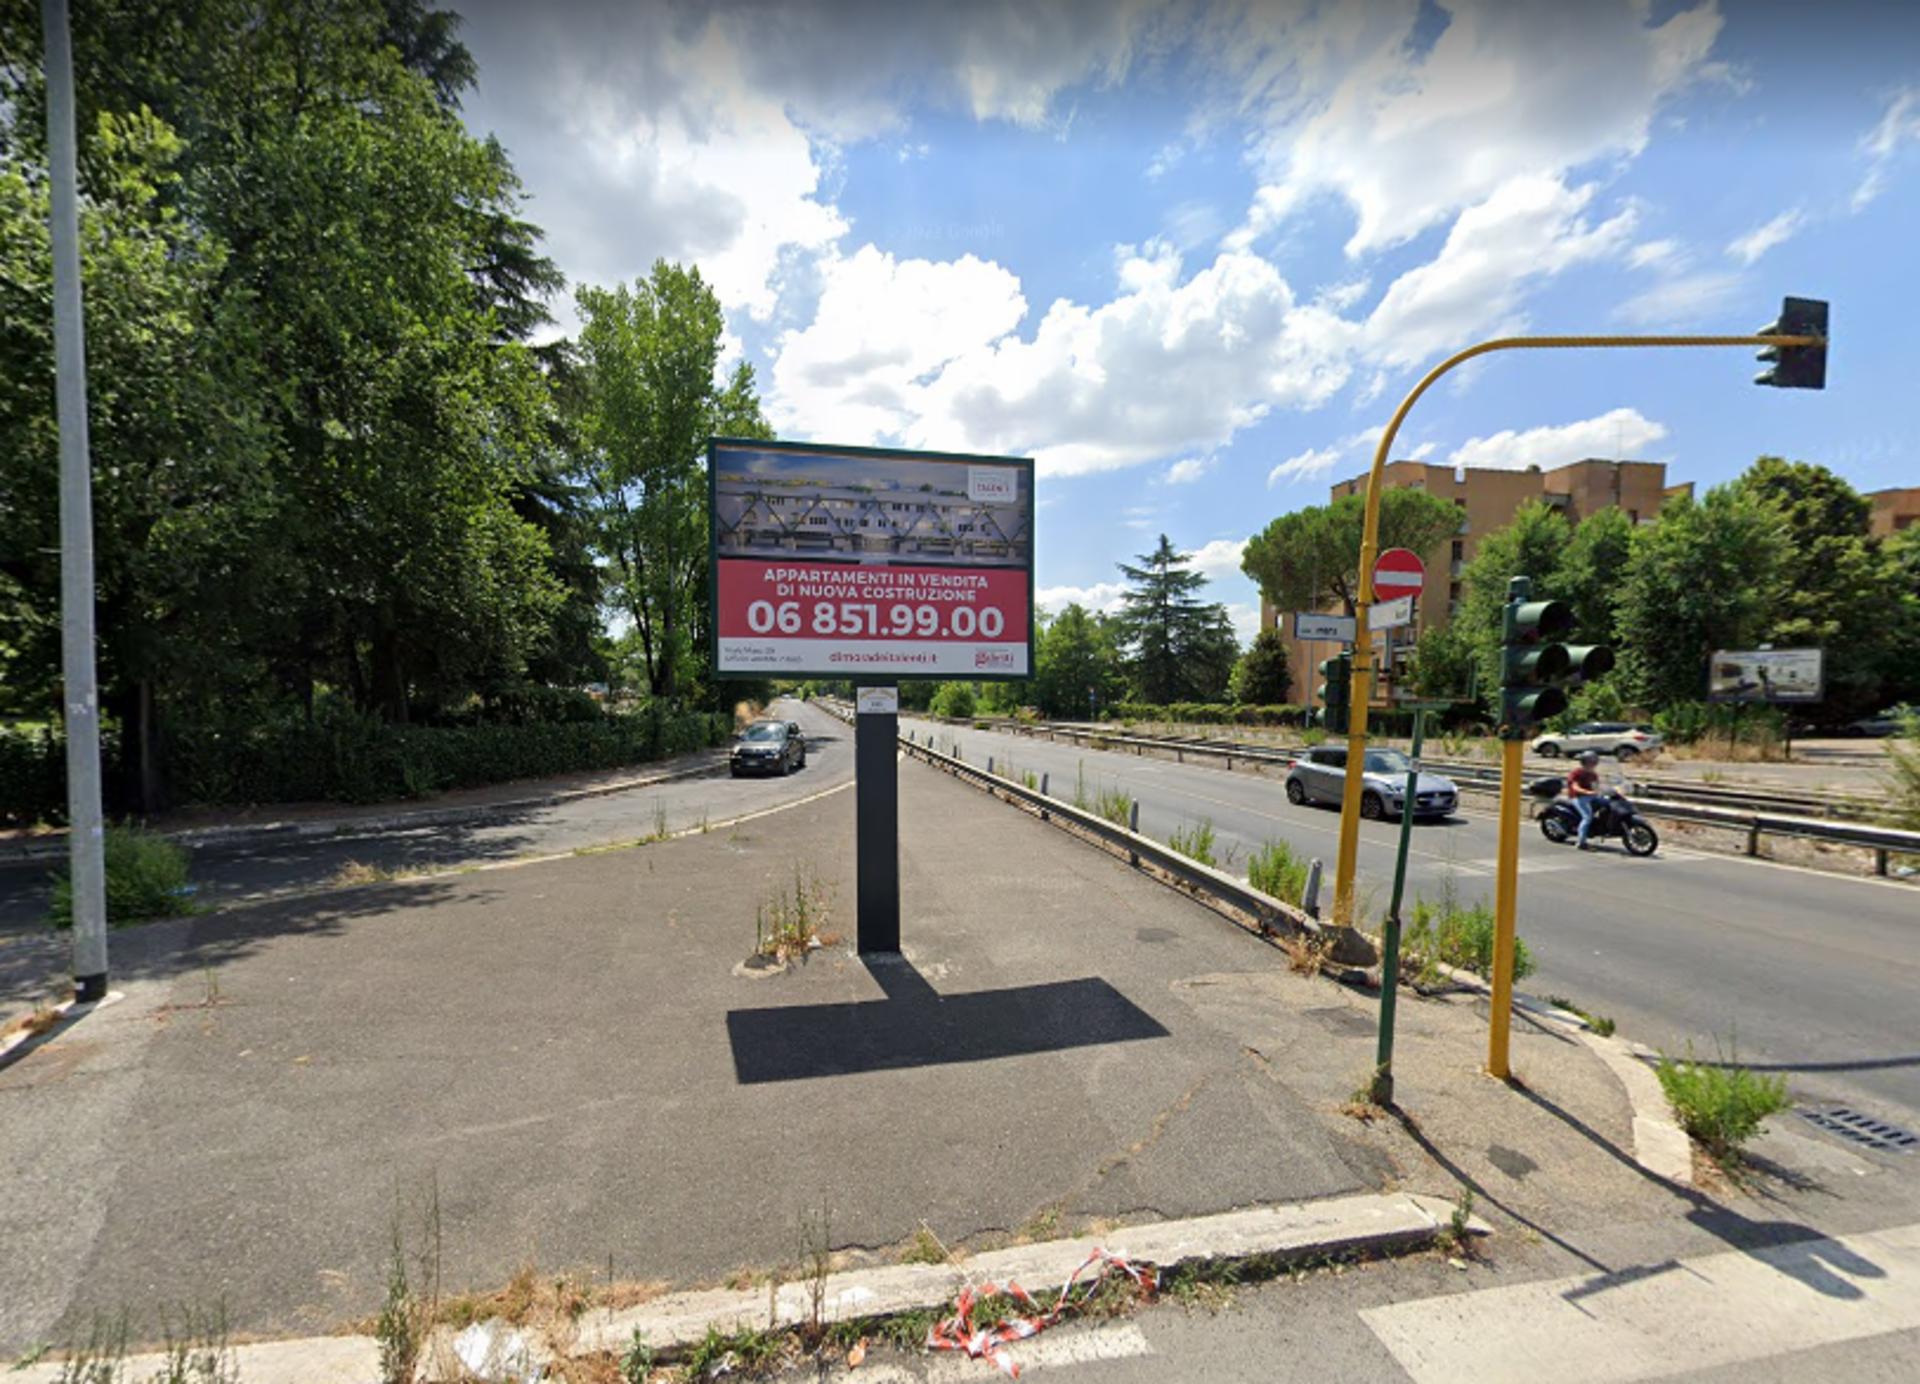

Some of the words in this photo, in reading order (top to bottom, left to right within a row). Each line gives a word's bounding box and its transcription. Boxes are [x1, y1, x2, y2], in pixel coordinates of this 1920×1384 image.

[764, 568, 895, 586] APPARTAMENTI
[898, 573, 915, 587] IN
[918, 574, 989, 589] VENDITA
[776, 583, 795, 597] DI
[799, 584, 859, 599] NUOVA
[862, 586, 977, 602] COSTRUZIONE
[747, 600, 801, 634] 06
[811, 602, 1004, 637] 851.99.00
